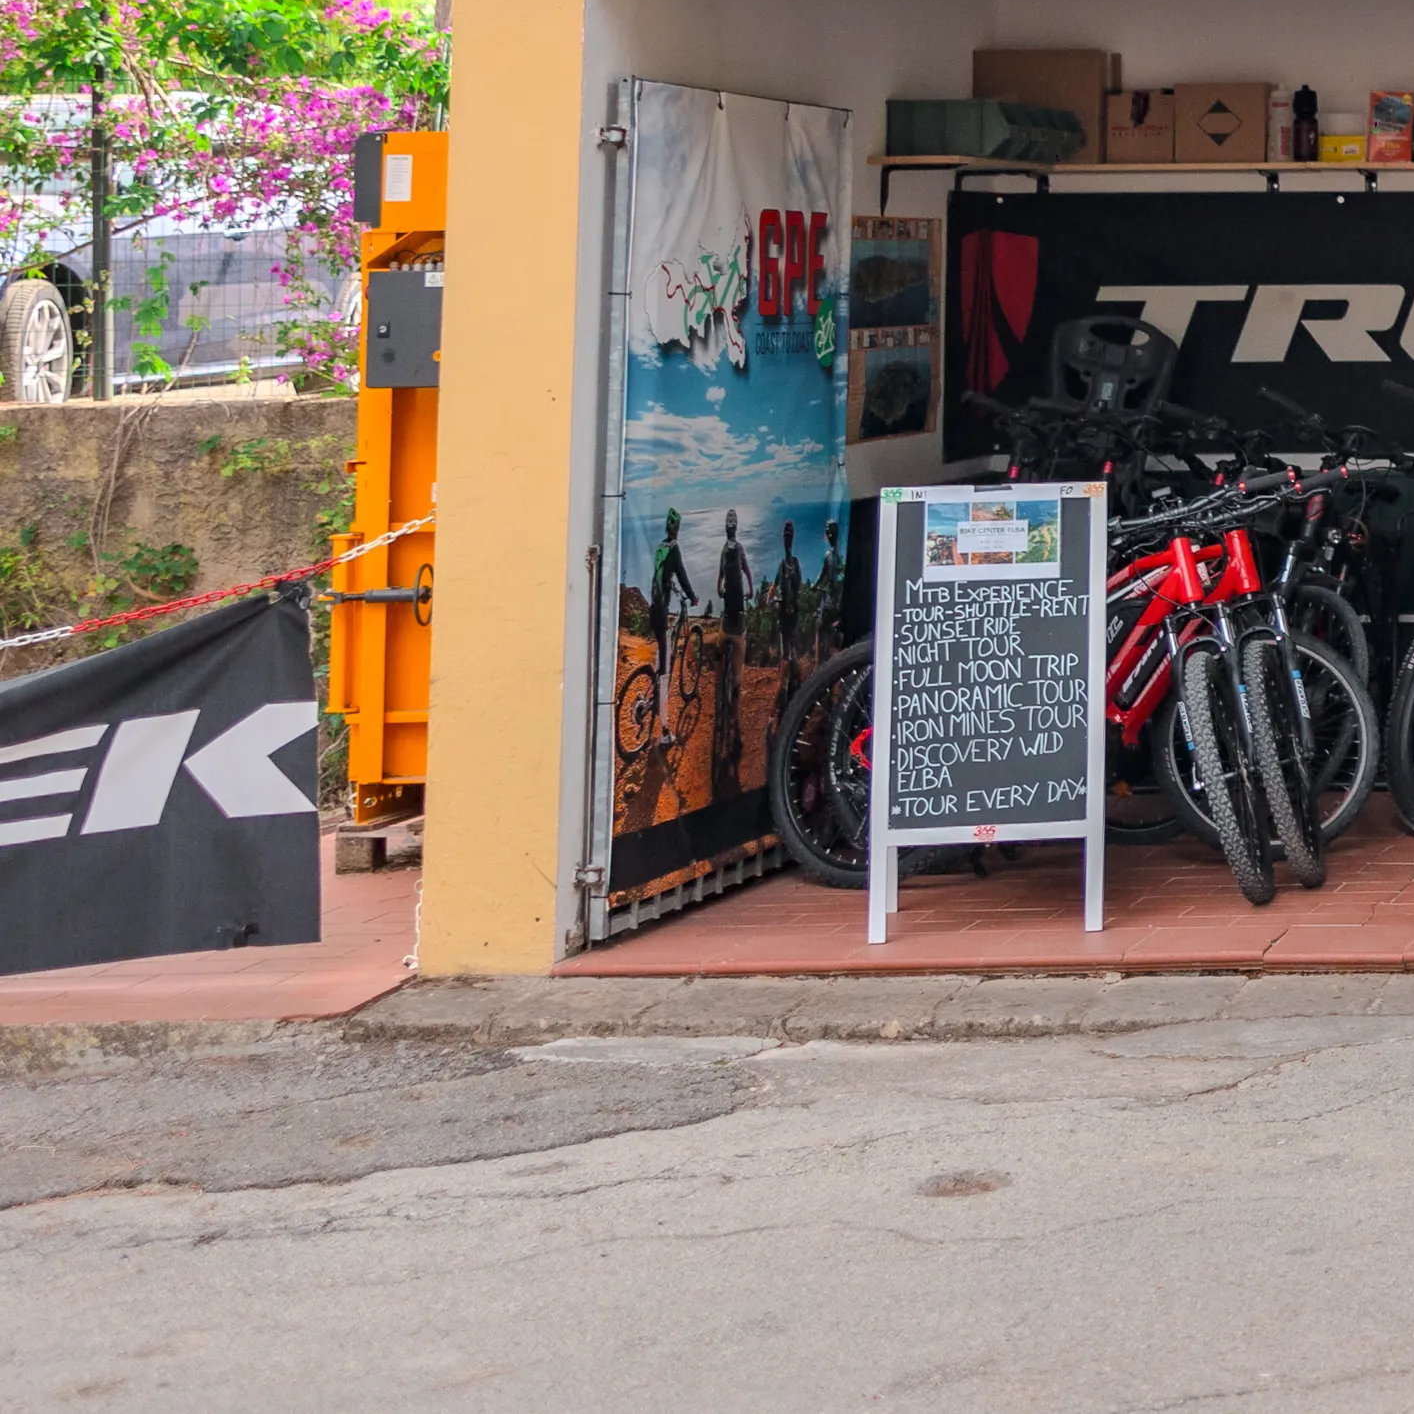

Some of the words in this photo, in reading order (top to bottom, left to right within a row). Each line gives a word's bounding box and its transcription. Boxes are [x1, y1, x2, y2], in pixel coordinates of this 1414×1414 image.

[757, 208, 828, 317] GPE
[755, 331, 780, 355] COAST
[955, 580, 1074, 603] EXPERIENCE
[901, 617, 981, 645] SUNSET
[983, 616, 1022, 637] RIDE
[899, 639, 957, 667] NIGHT
[960, 634, 1025, 660] TOUR
[899, 664, 952, 691] FULL
[957, 657, 1022, 684] MOON
[1028, 653, 1079, 678] TRIP
[898, 682, 1024, 719] PANORAMIC
[1027, 679, 1089, 704] TOUR
[897, 716, 945, 746] IRON
[949, 708, 1016, 737] MINES
[1019, 704, 1088, 731] TOUR
[897, 737, 1014, 771] DISCOVERY
[1019, 731, 1064, 756] WILD
[897, 766, 954, 793] ELBA
[898, 794, 959, 817] TOUR
[966, 782, 1041, 812] EVERY
[1047, 776, 1085, 803] DAY
